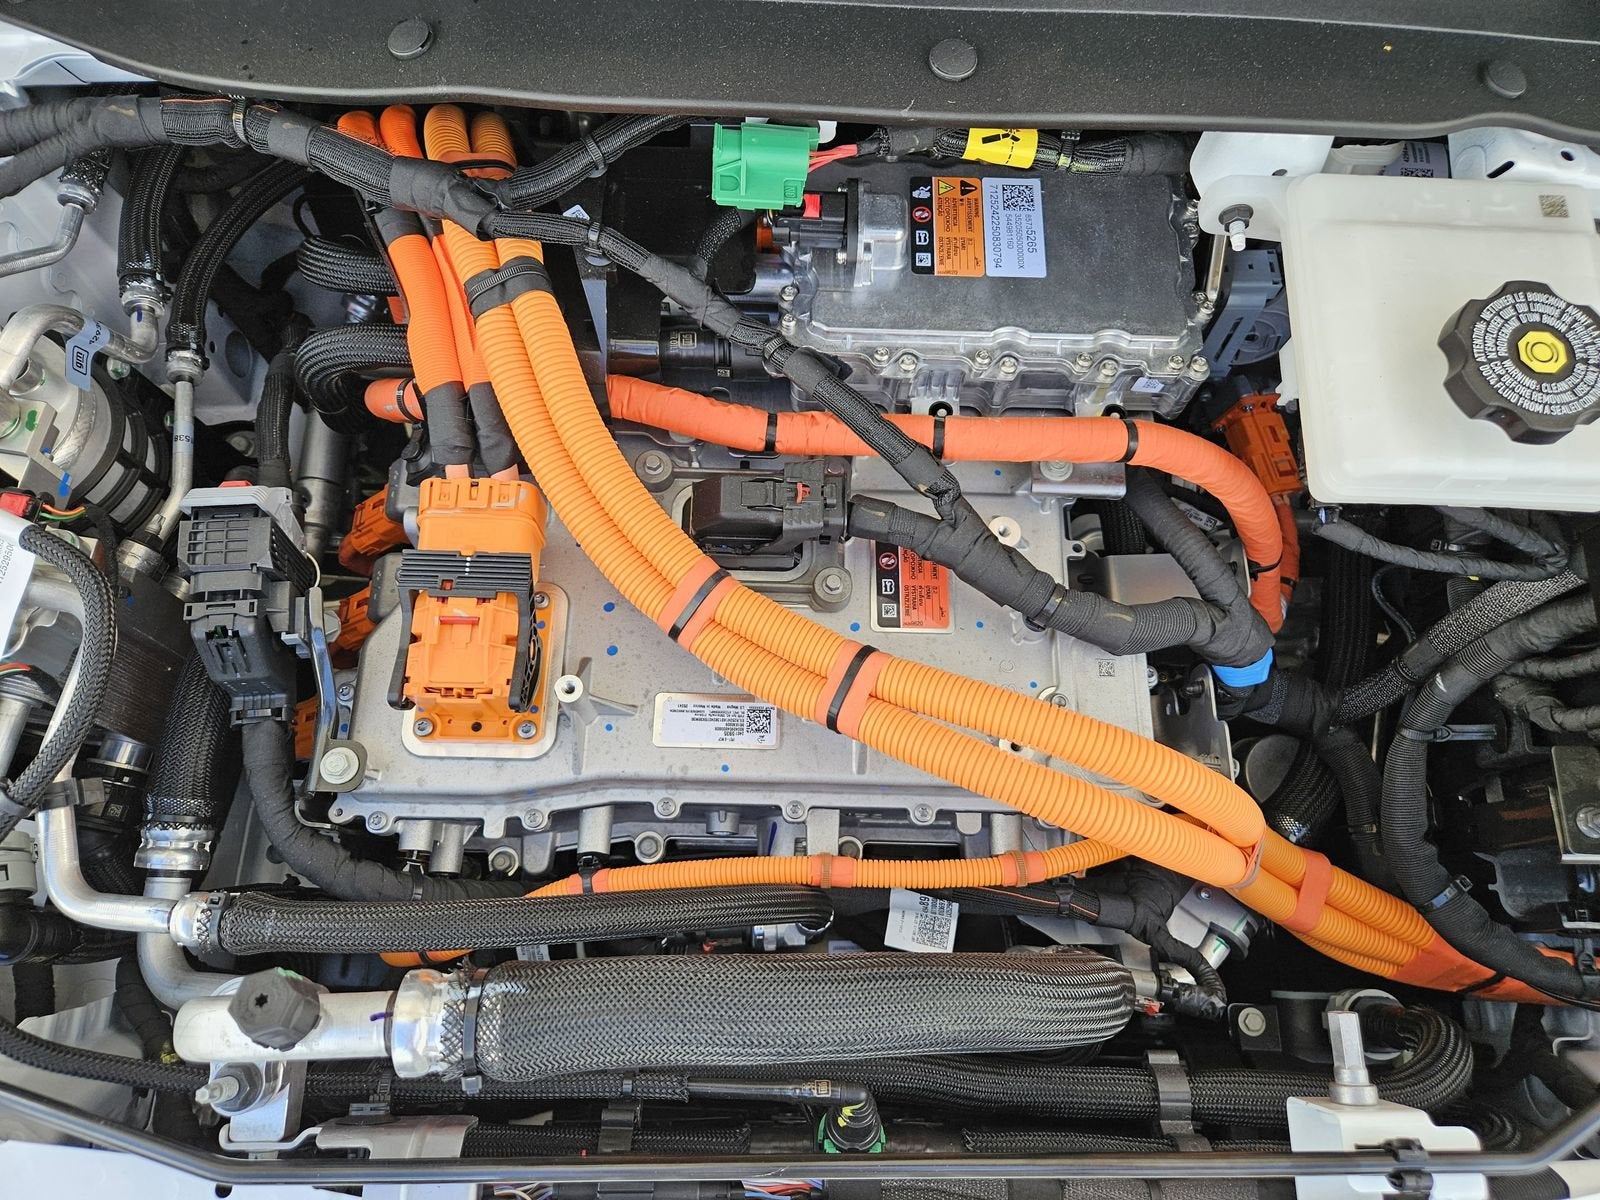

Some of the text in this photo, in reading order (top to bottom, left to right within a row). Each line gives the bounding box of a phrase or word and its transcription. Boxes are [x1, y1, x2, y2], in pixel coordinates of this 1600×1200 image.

[76, 351, 84, 370] gm
[1480, 364, 1500, 385] DOT4
[1493, 382, 1520, 403] FLUID
[1517, 397, 1544, 413] FROM
[1543, 404, 1550, 415] A
[1490, 361, 1506, 375] CAP
[1500, 374, 1532, 398] BEFORE
